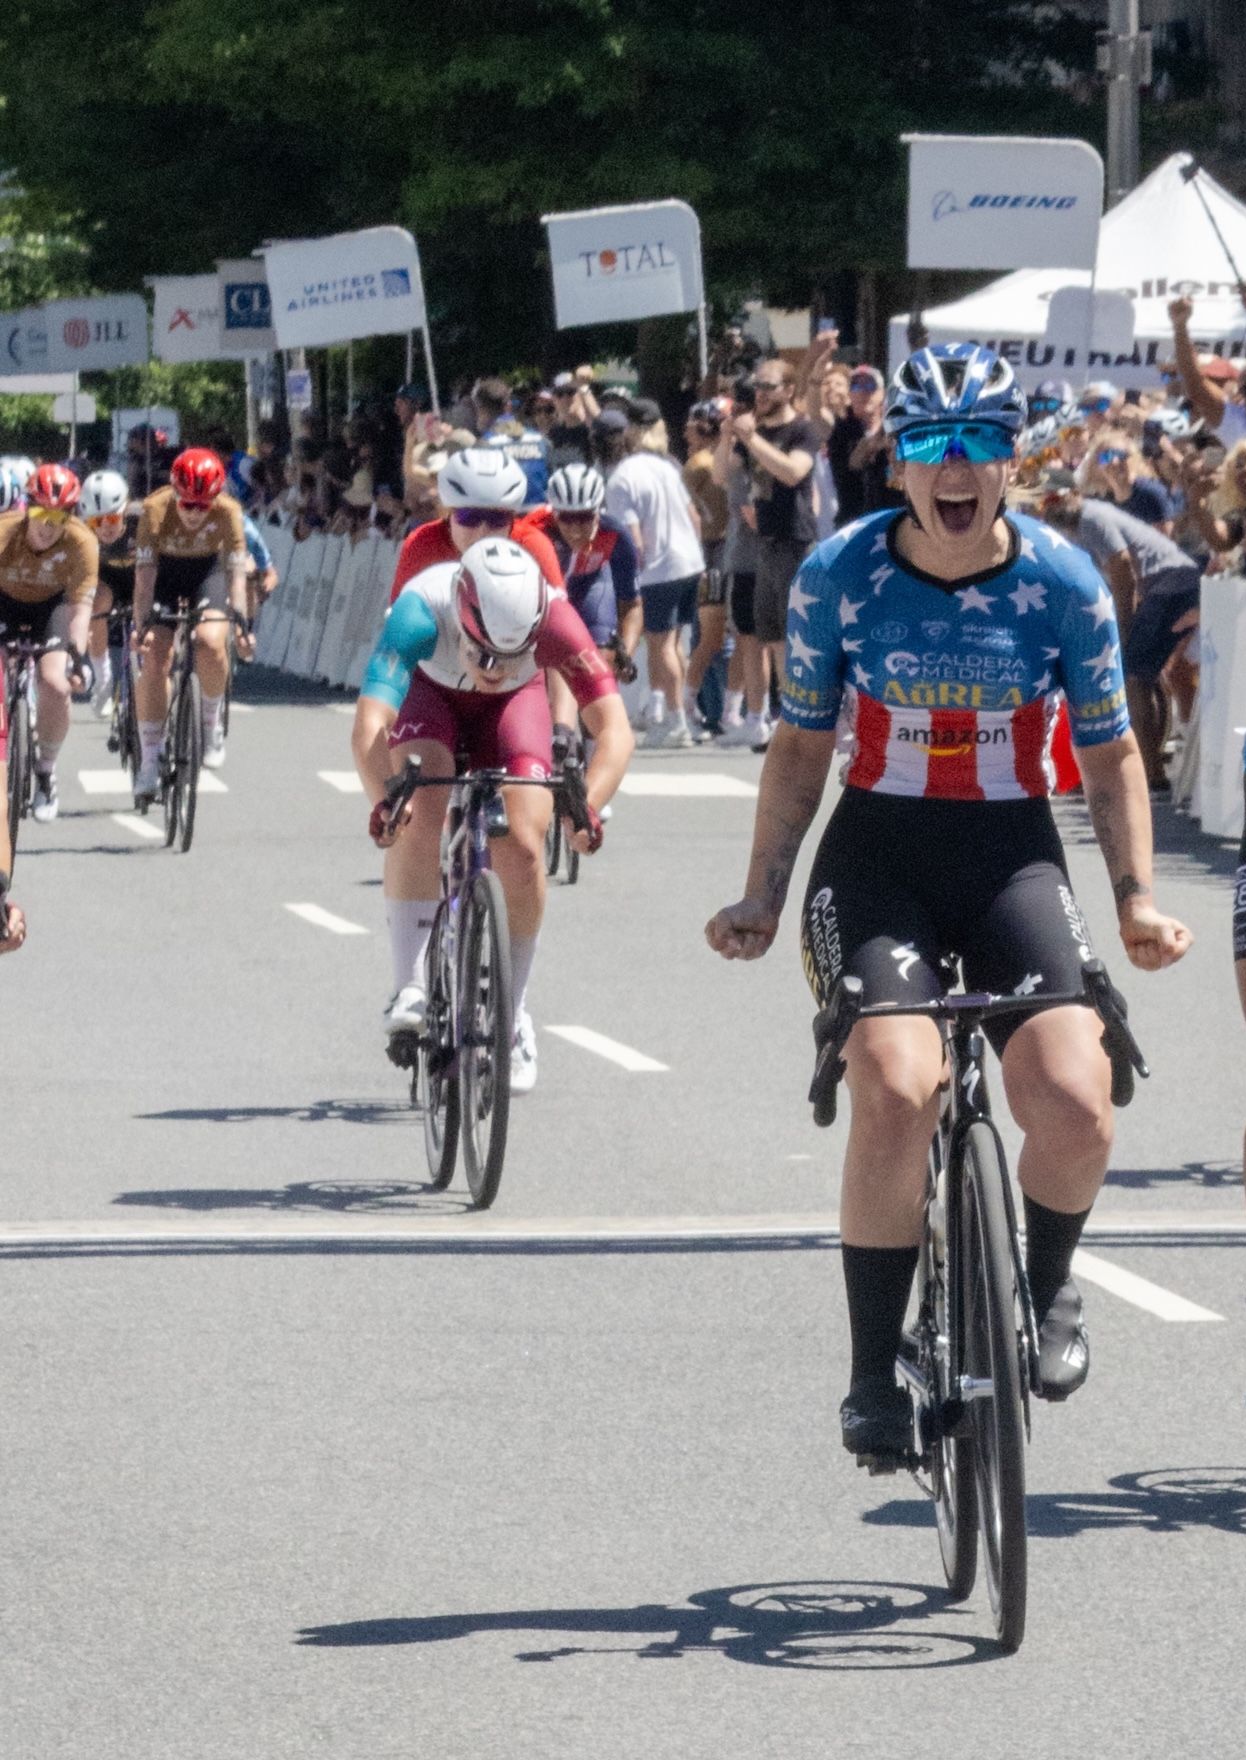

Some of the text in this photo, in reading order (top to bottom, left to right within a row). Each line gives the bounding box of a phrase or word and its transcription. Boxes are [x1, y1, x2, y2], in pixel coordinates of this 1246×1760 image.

[968, 194, 1078, 210] BOEING
[578, 241, 676, 278] TOTAL
[303, 273, 376, 295] UNITED
[287, 287, 377, 312] AIRLINES
[922, 652, 1027, 671] CALDERA
[921, 666, 1024, 683] MEDICAL
[897, 727, 1008, 746] amazon
